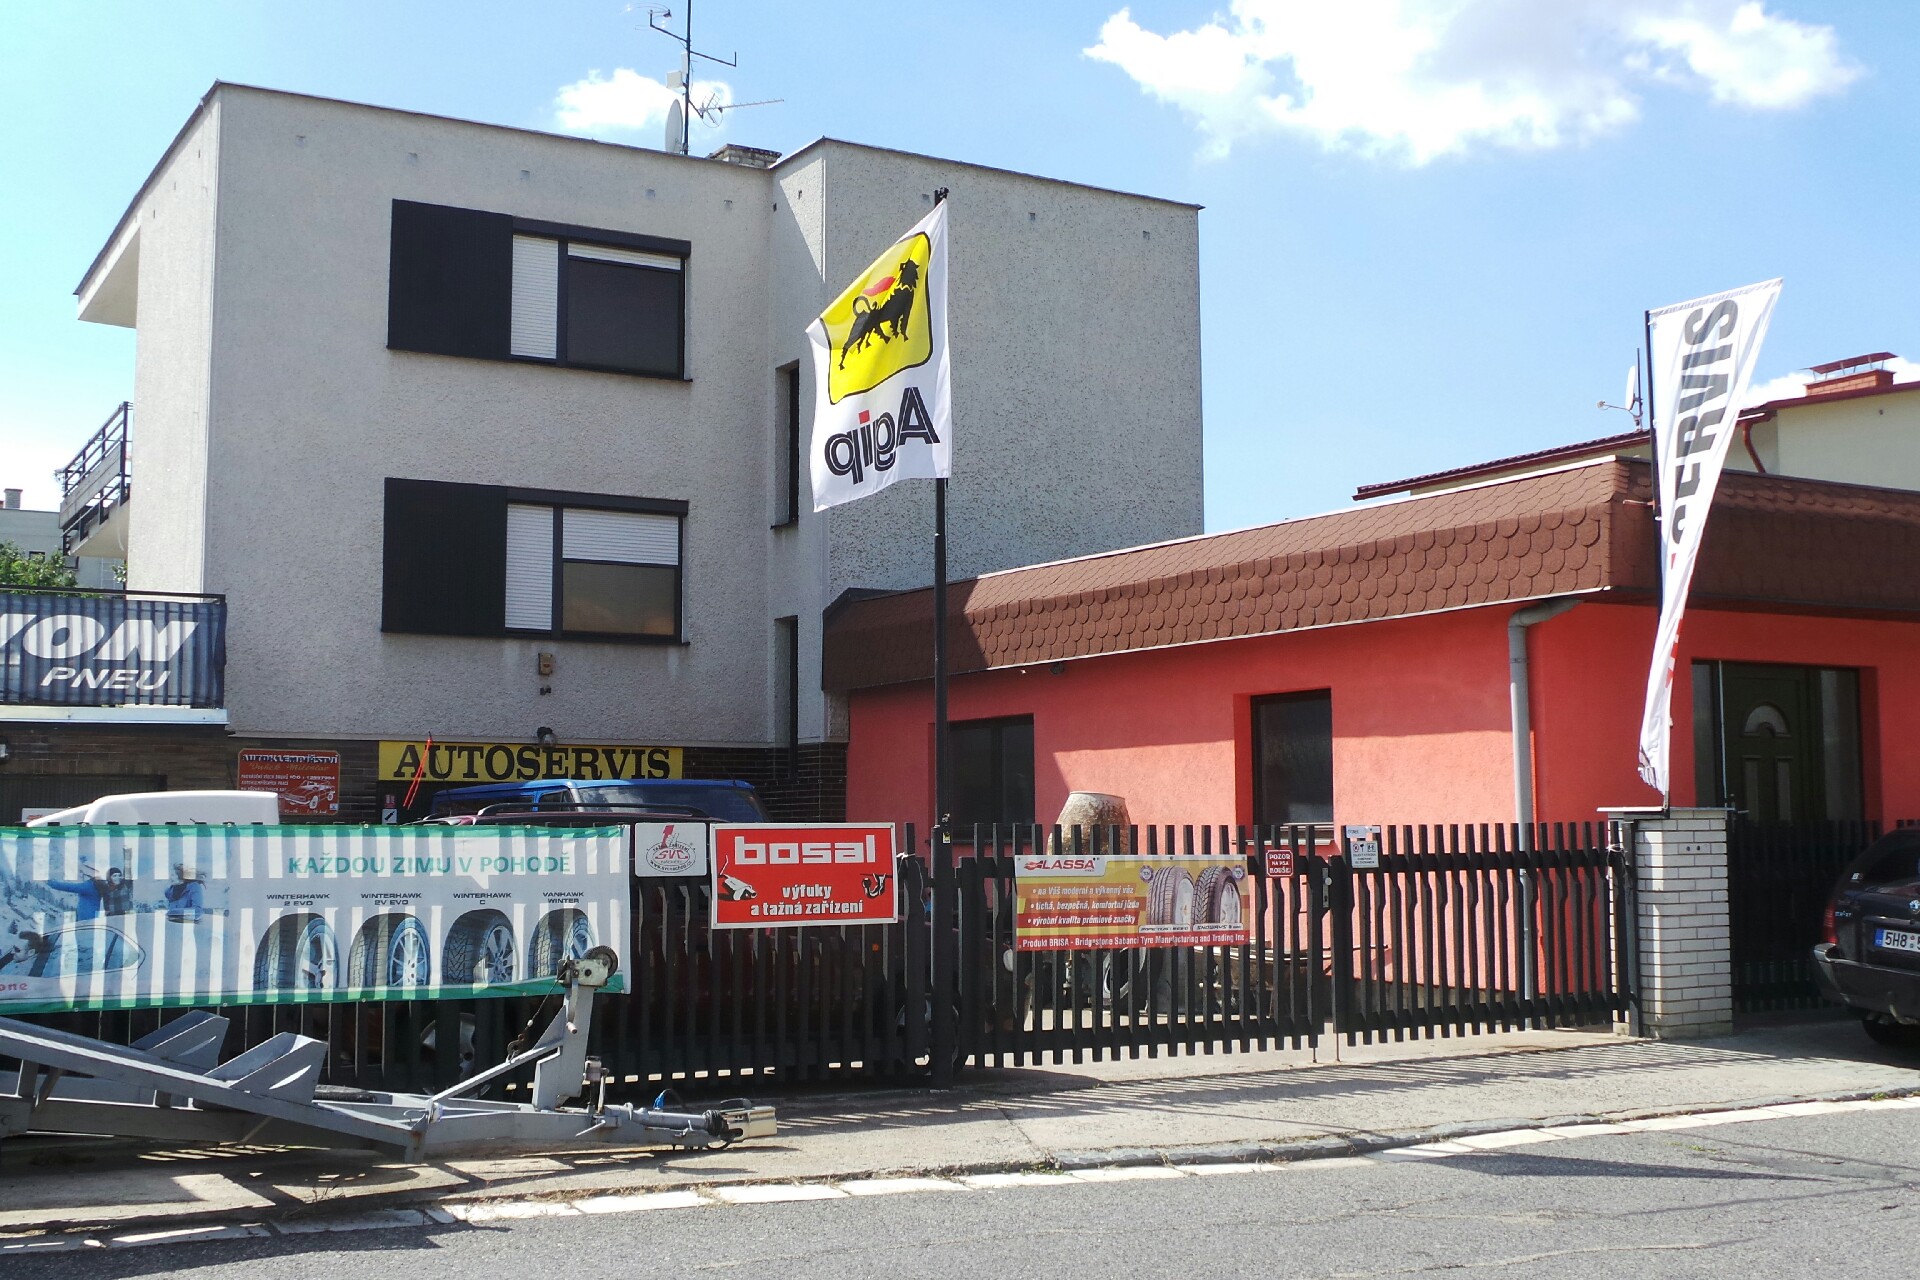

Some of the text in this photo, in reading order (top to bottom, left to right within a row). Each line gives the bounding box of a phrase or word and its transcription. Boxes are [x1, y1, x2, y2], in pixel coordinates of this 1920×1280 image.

[40, 666, 172, 690] PNEU
[393, 745, 670, 781] AUTOSERVIS
[654, 849, 689, 860] SVC
[734, 834, 876, 865] bosal
[288, 851, 571, 874] KAŽDOU ZIMU V POHODĚ
[1041, 859, 1095, 870] LASSA
[782, 884, 832, 900] výfuky
[1037, 887, 1047, 896] na
[1048, 885, 1061, 894] Váš
[1061, 885, 1088, 895] moderní
[1095, 885, 1121, 896] výkonný
[750, 899, 863, 916] a tažná zařízení
[1035, 901, 1056, 911] tichá,
[1057, 900, 1090, 911] bezpečná,
[1091, 900, 1123, 909] komfortní
[1032, 914, 1136, 927] výrobní kvalita prémiové značky
[1022, 939, 1048, 948] Produkt
[1049, 938, 1069, 947] BRISA
[1075, 937, 1113, 948] Bridgestone
[1114, 936, 1139, 945] Sabanci
[1140, 936, 1154, 945] Tyre
[1199, 934, 1211, 942] and
[1212, 933, 1234, 943] Trading
[1235, 933, 1245, 941] Inc
